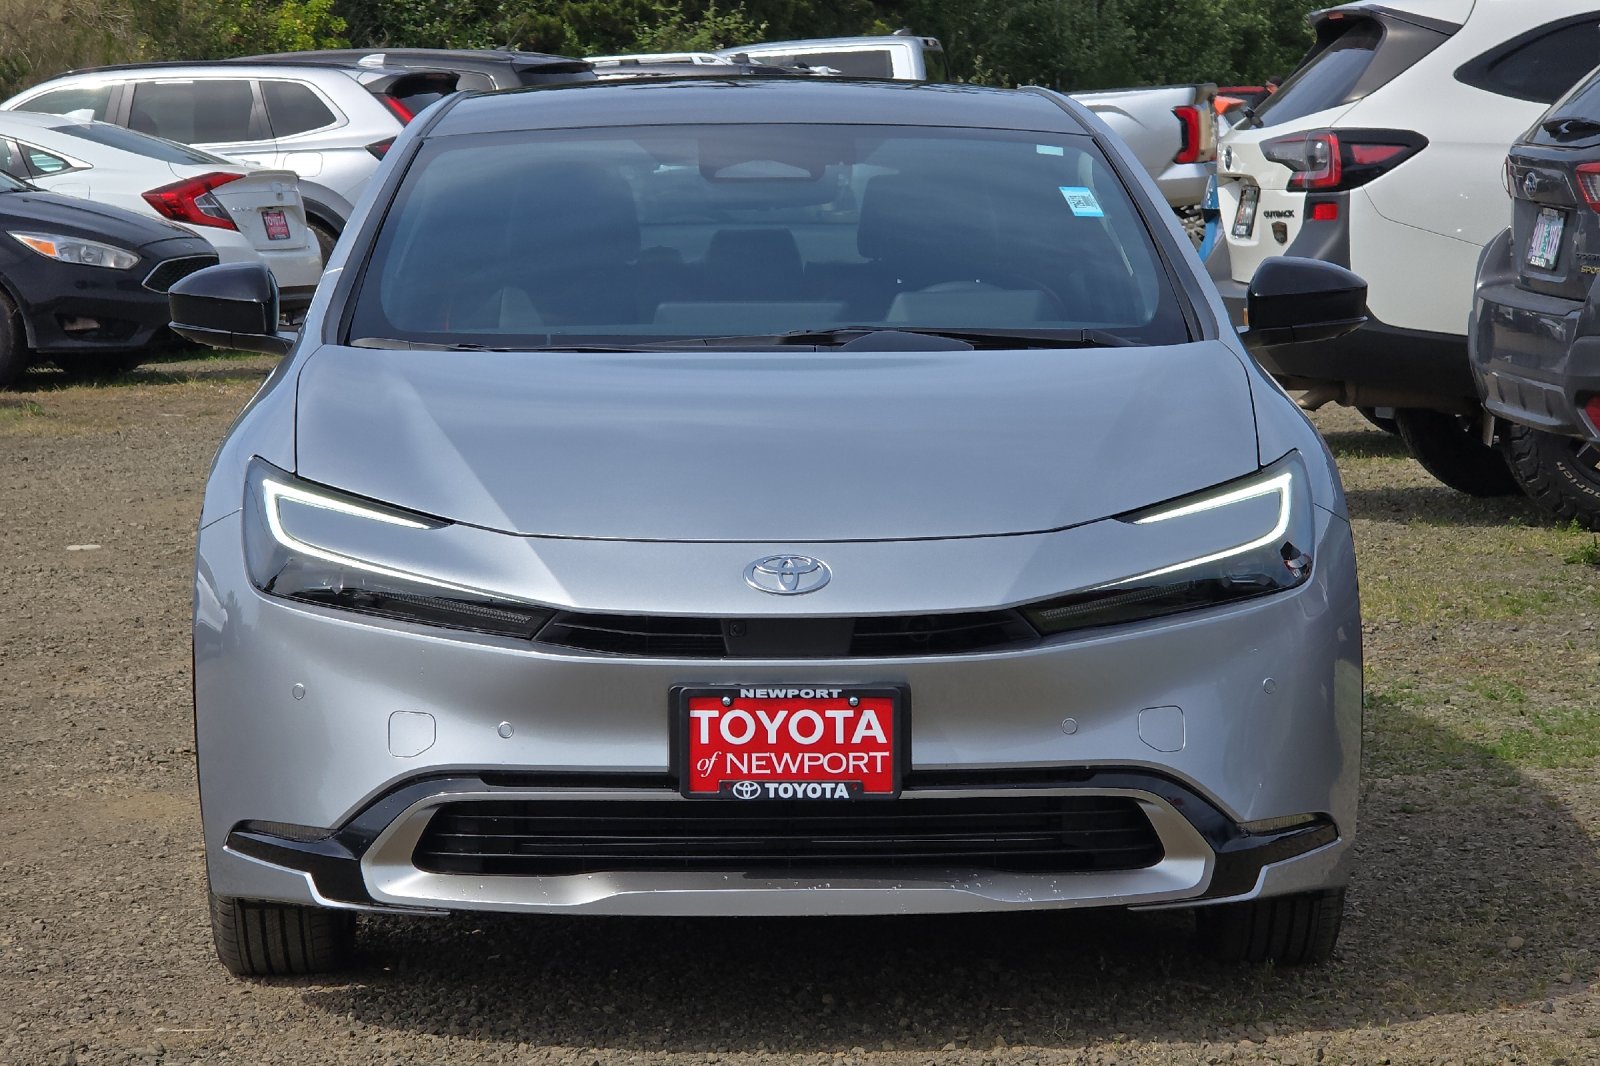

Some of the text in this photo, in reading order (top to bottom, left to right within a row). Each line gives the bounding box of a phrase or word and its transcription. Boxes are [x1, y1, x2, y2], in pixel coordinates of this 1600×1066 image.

[1263, 209, 1295, 219] OUTBACK
[740, 688, 842, 699] NEWPORT
[689, 708, 888, 745] TOYOTA
[696, 751, 890, 777] of NEWPORT
[764, 782, 850, 799] TOYOTA
